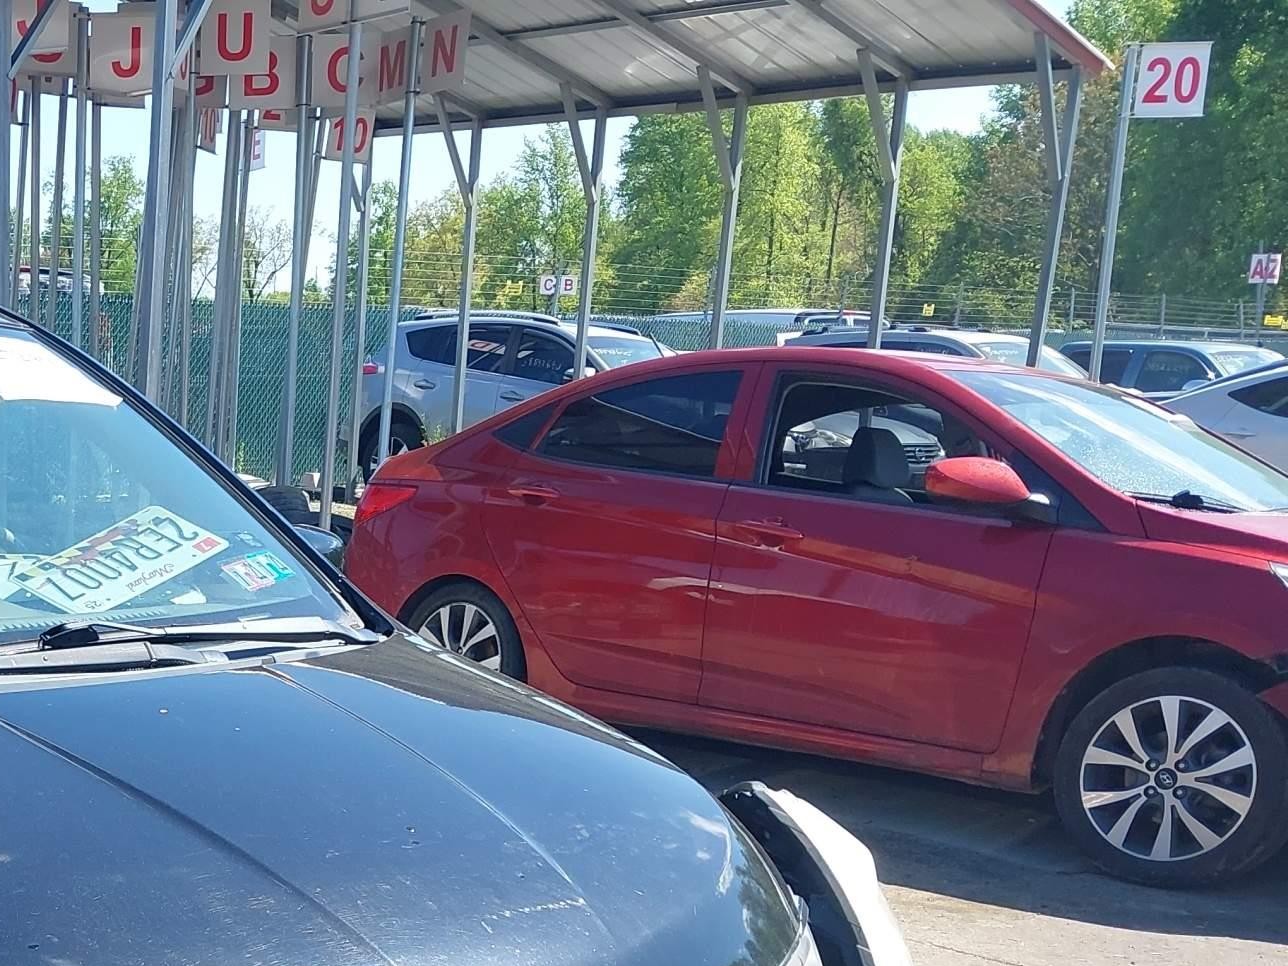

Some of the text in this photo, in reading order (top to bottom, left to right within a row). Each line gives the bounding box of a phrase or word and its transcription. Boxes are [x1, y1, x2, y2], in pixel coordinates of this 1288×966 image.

[112, 26, 142, 78] J
[217, 12, 253, 61] U
[431, 25, 458, 77] N
[244, 51, 280, 97] B
[327, 46, 364, 93] C
[379, 40, 406, 92] M
[1141, 56, 1201, 104] 20
[333, 116, 368, 154] 10
[544, 278, 553, 291] C
[564, 278, 573, 291] B
